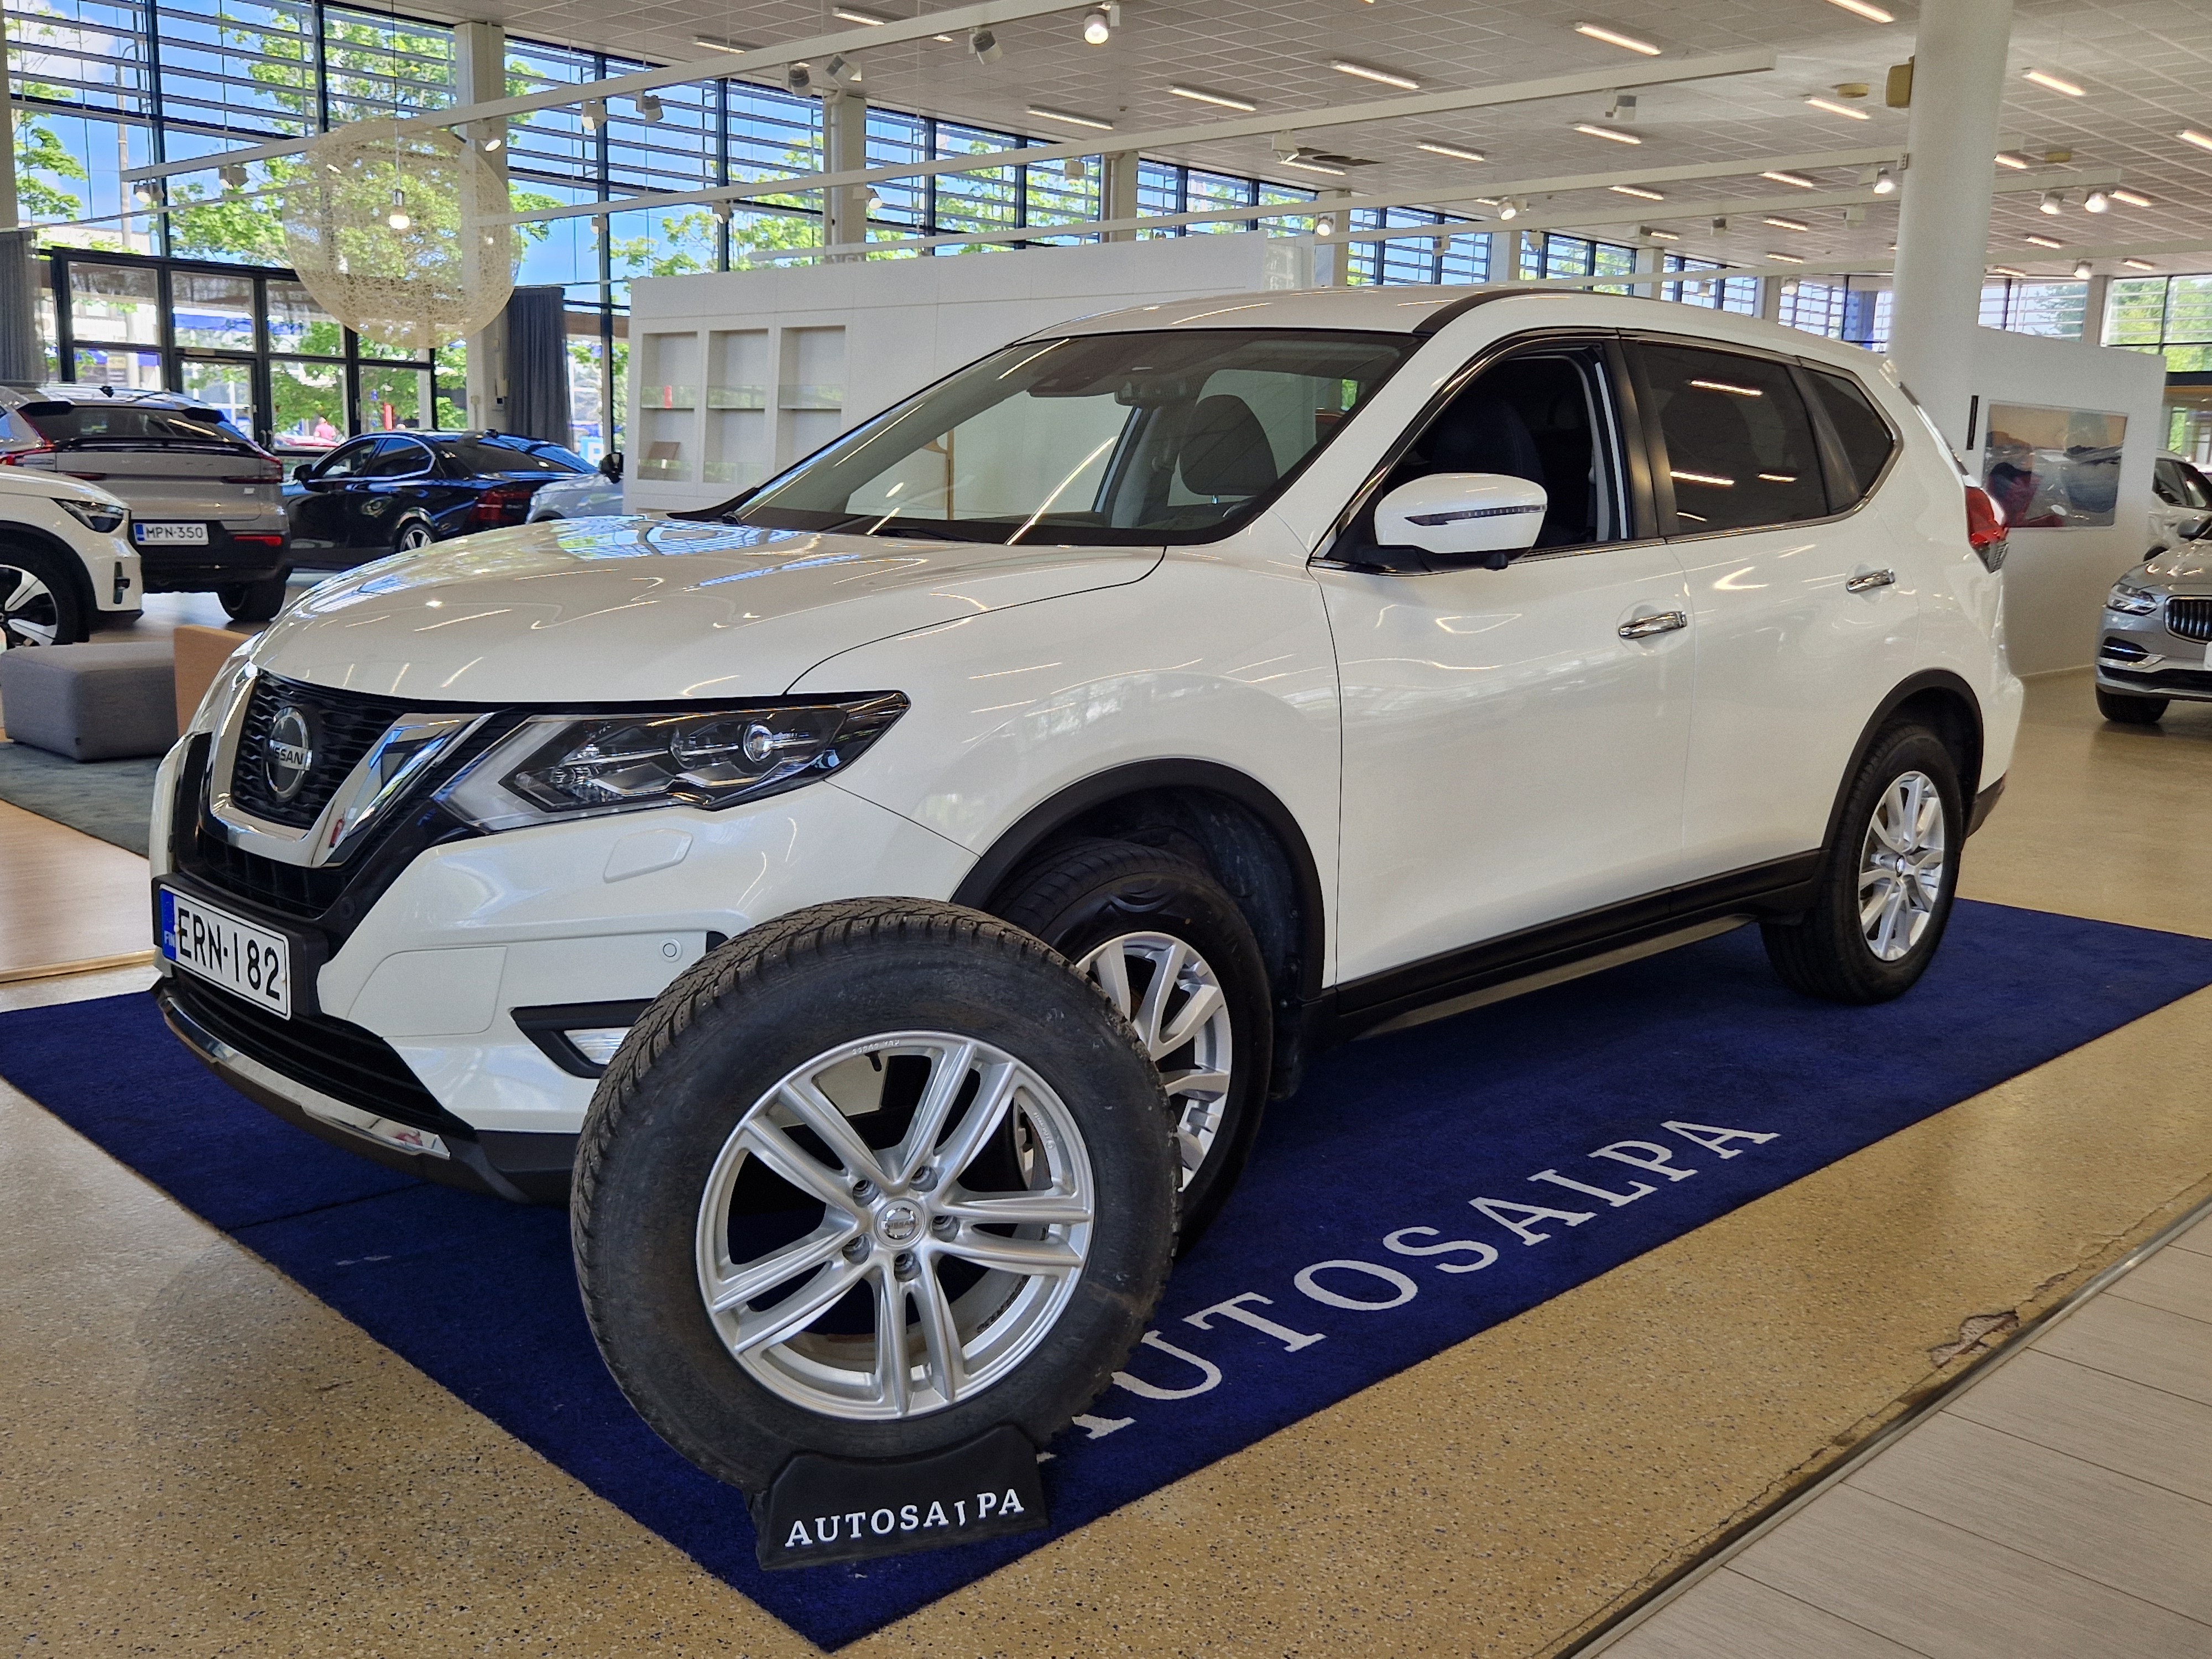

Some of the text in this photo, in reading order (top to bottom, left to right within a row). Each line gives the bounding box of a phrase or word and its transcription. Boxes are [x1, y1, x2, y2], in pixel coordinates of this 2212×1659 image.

[146, 526, 204, 539] MPN-350
[269, 745, 304, 765] SSAN
[178, 906, 280, 1001] ERN-182
